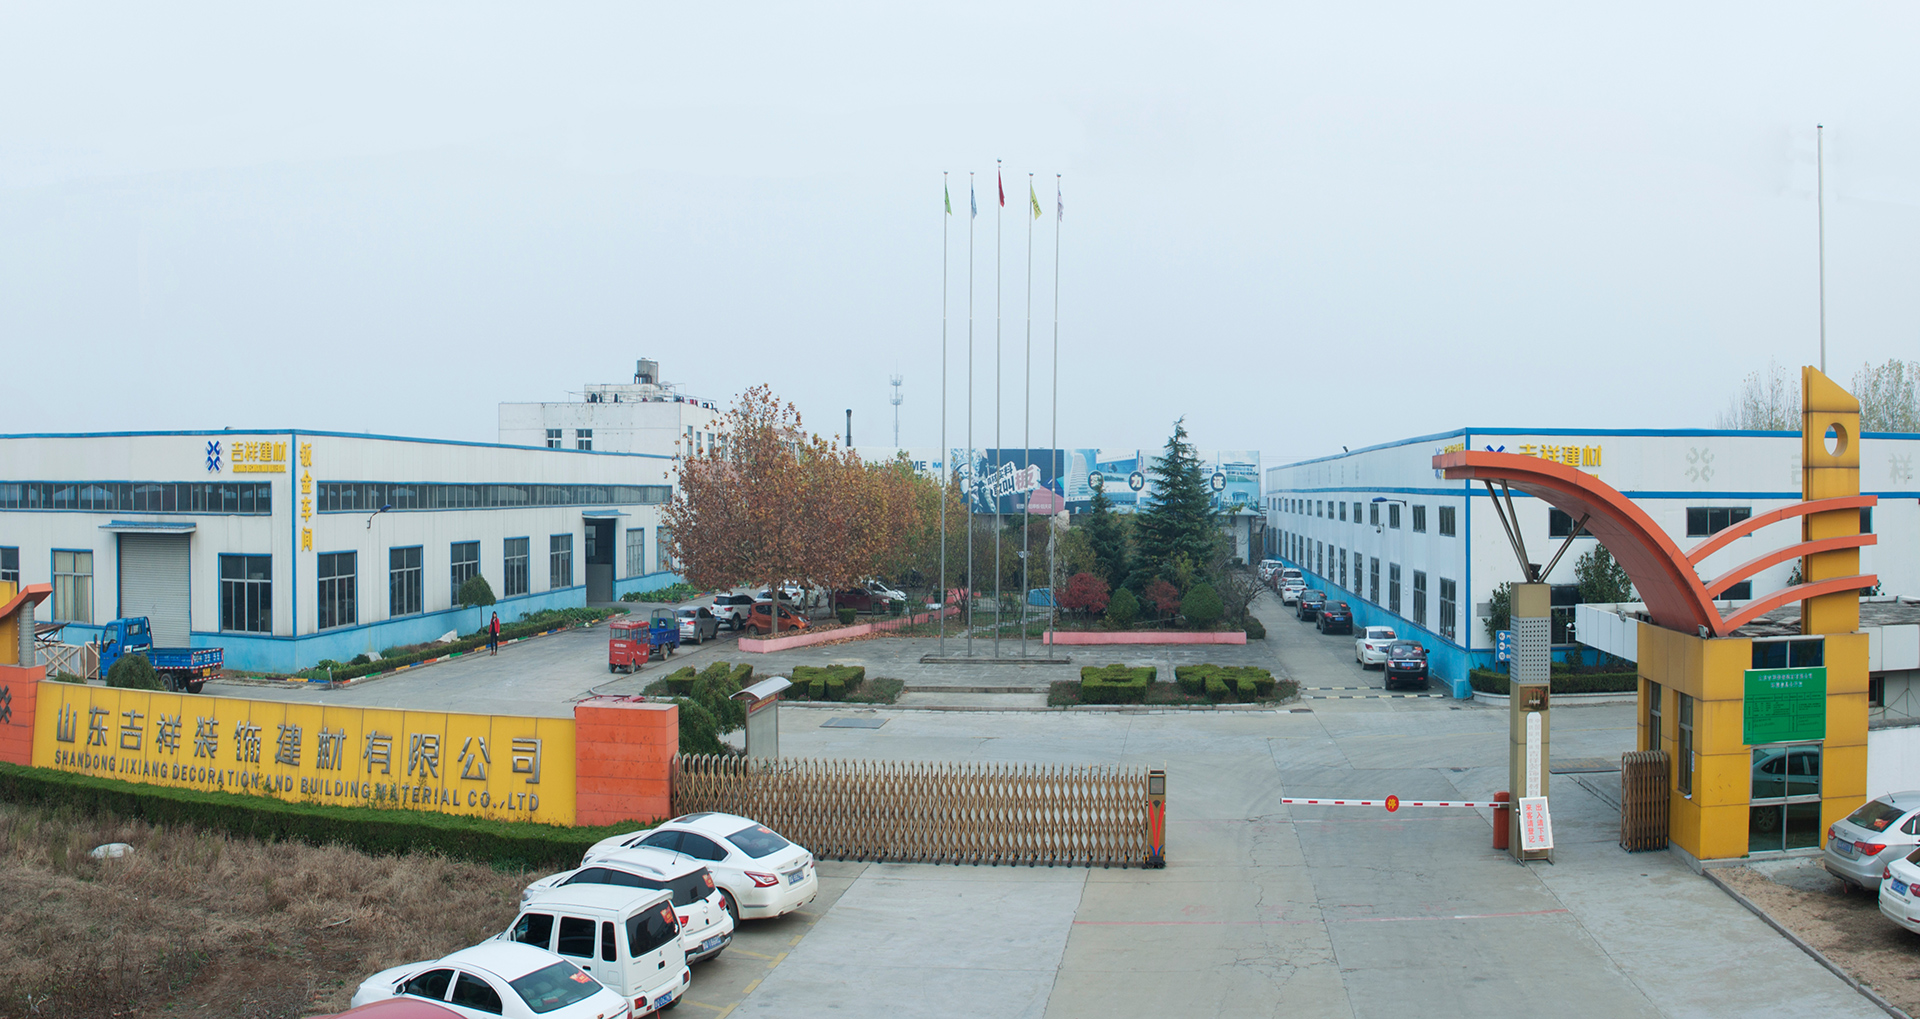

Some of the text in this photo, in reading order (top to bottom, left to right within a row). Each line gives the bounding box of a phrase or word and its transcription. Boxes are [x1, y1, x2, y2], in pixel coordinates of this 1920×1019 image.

[231, 441, 287, 461] 吉祥建材
[300, 441, 313, 552] 钣金车间
[57, 703, 542, 784] 山东吉祥装饰建材有限公司
[55, 749, 116, 774] SHANDONG
[119, 757, 168, 778] JIXIANG
[172, 765, 259, 789] DECORATION
[265, 773, 293, 793] AND
[300, 777, 370, 799] BUILDING
[377, 781, 461, 806] MATERIAL
[1525, 803, 1536, 843] 来客请登记
[1535, 803, 1546, 843] 出入请下车
